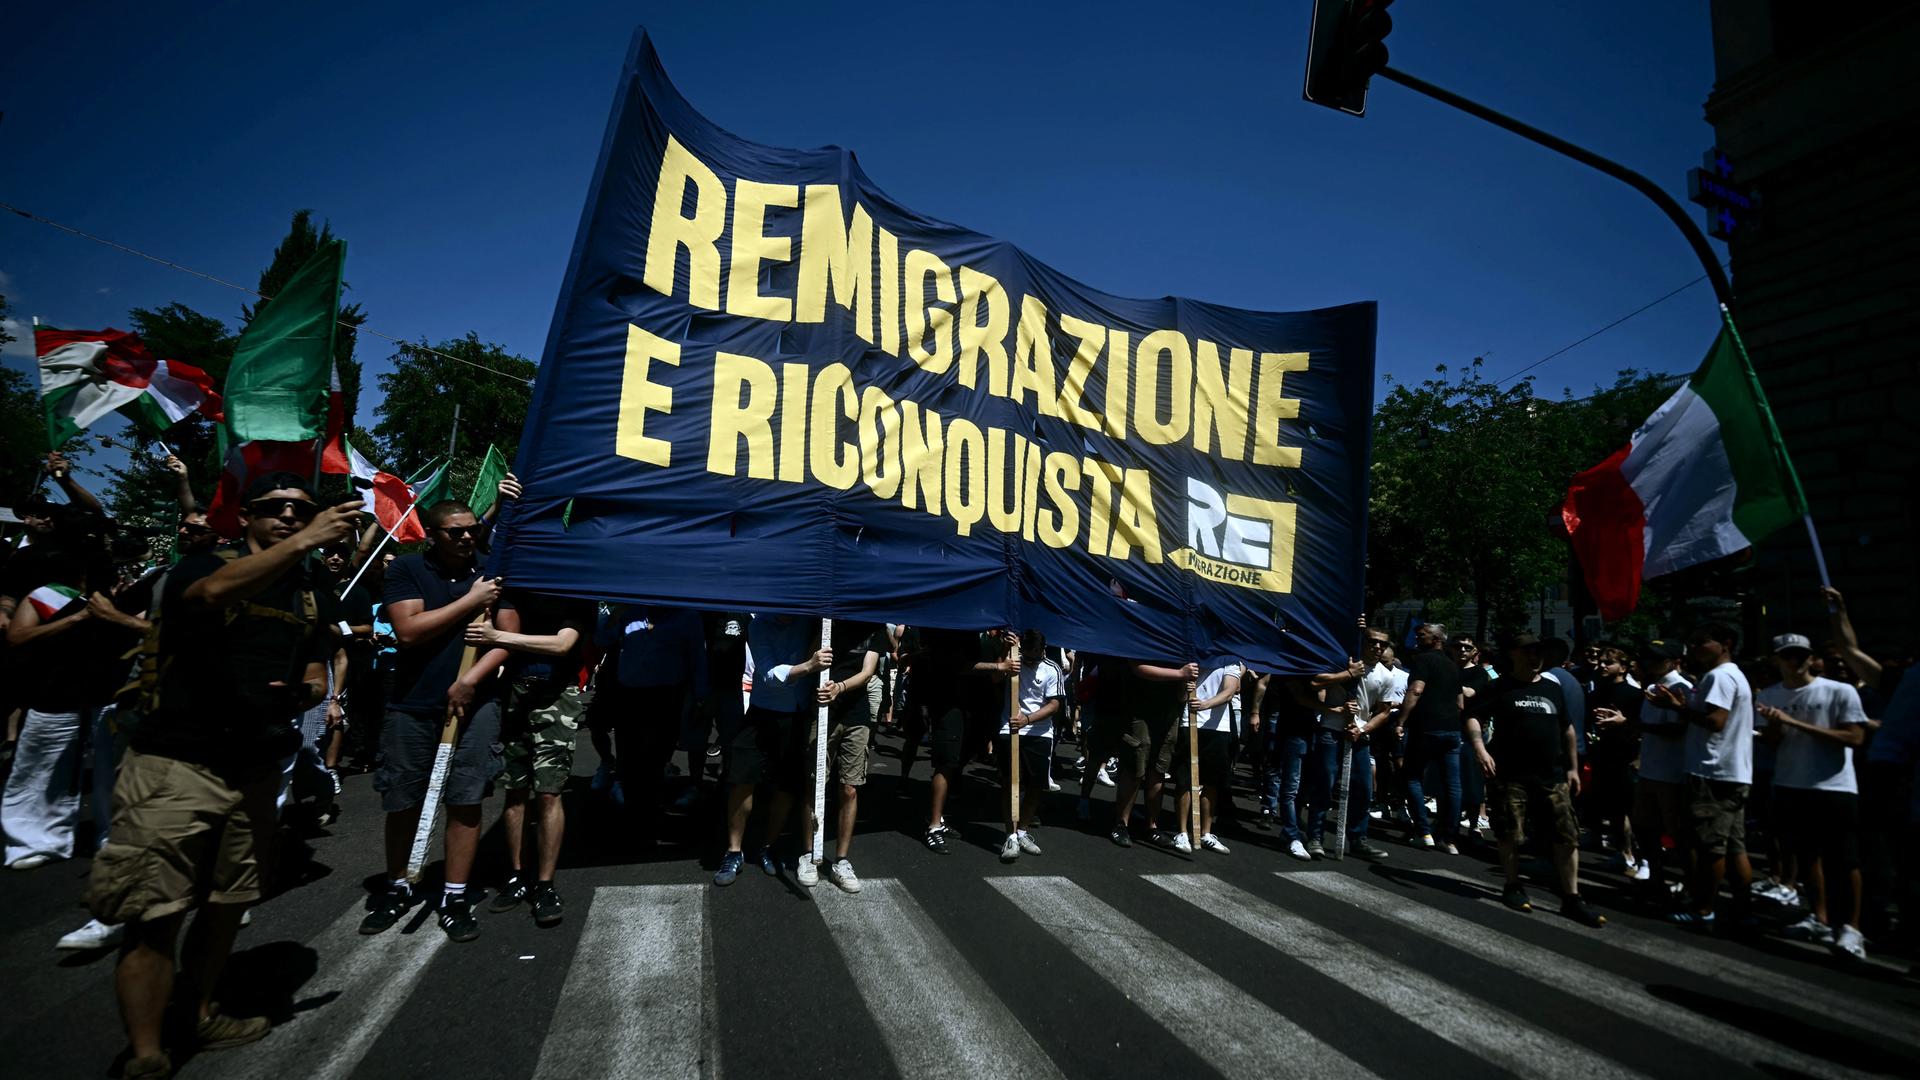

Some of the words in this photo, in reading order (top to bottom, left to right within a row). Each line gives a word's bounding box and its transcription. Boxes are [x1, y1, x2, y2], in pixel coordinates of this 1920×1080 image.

[643, 134, 1311, 469] REMIGRAZIONE
[615, 323, 681, 468] E
[705, 352, 1165, 565] RICONQUISTA
[1187, 476, 1271, 569] RE
